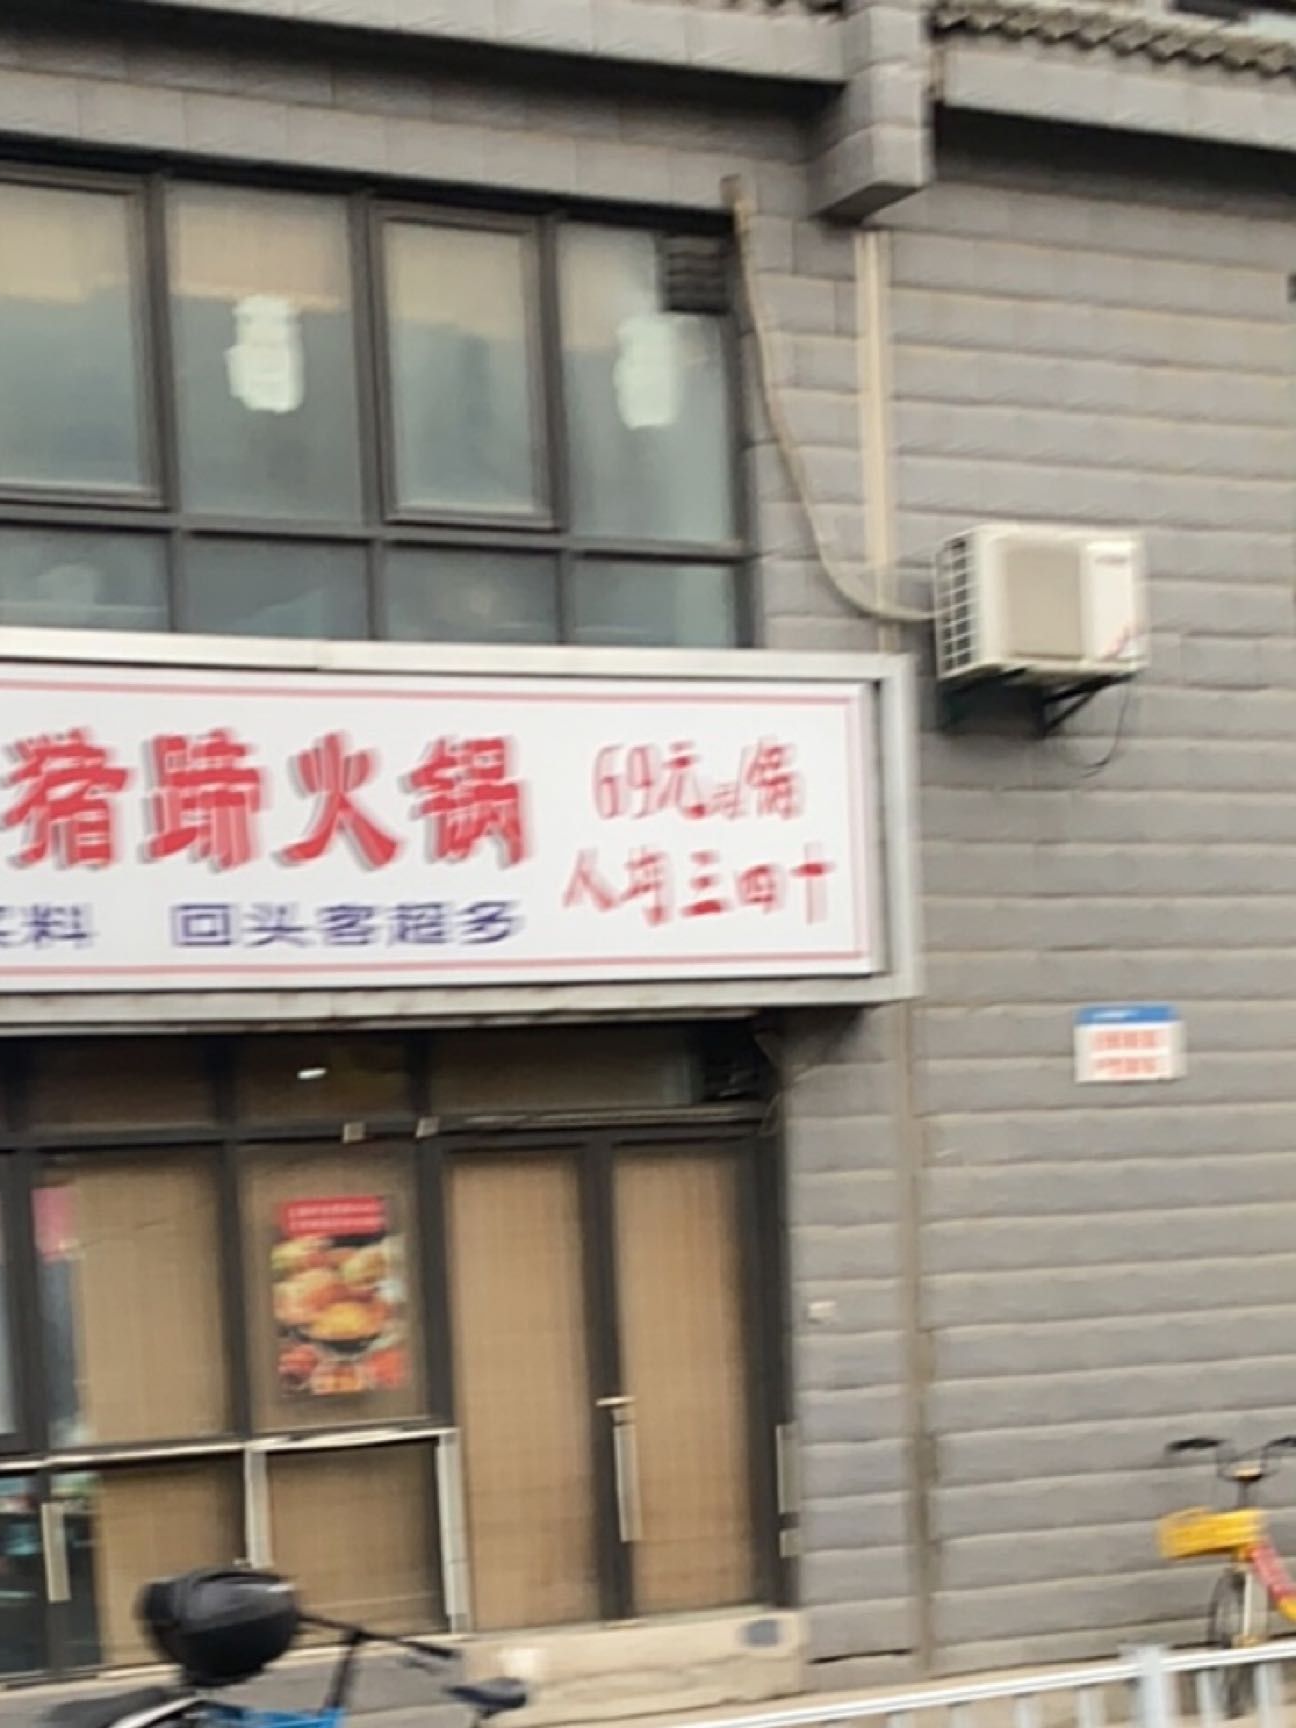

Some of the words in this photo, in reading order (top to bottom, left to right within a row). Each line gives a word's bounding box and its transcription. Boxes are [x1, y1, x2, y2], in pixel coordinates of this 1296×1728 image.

[560, 845, 834, 926] 人均三四十
[168, 898, 526, 948] 回头客超多
